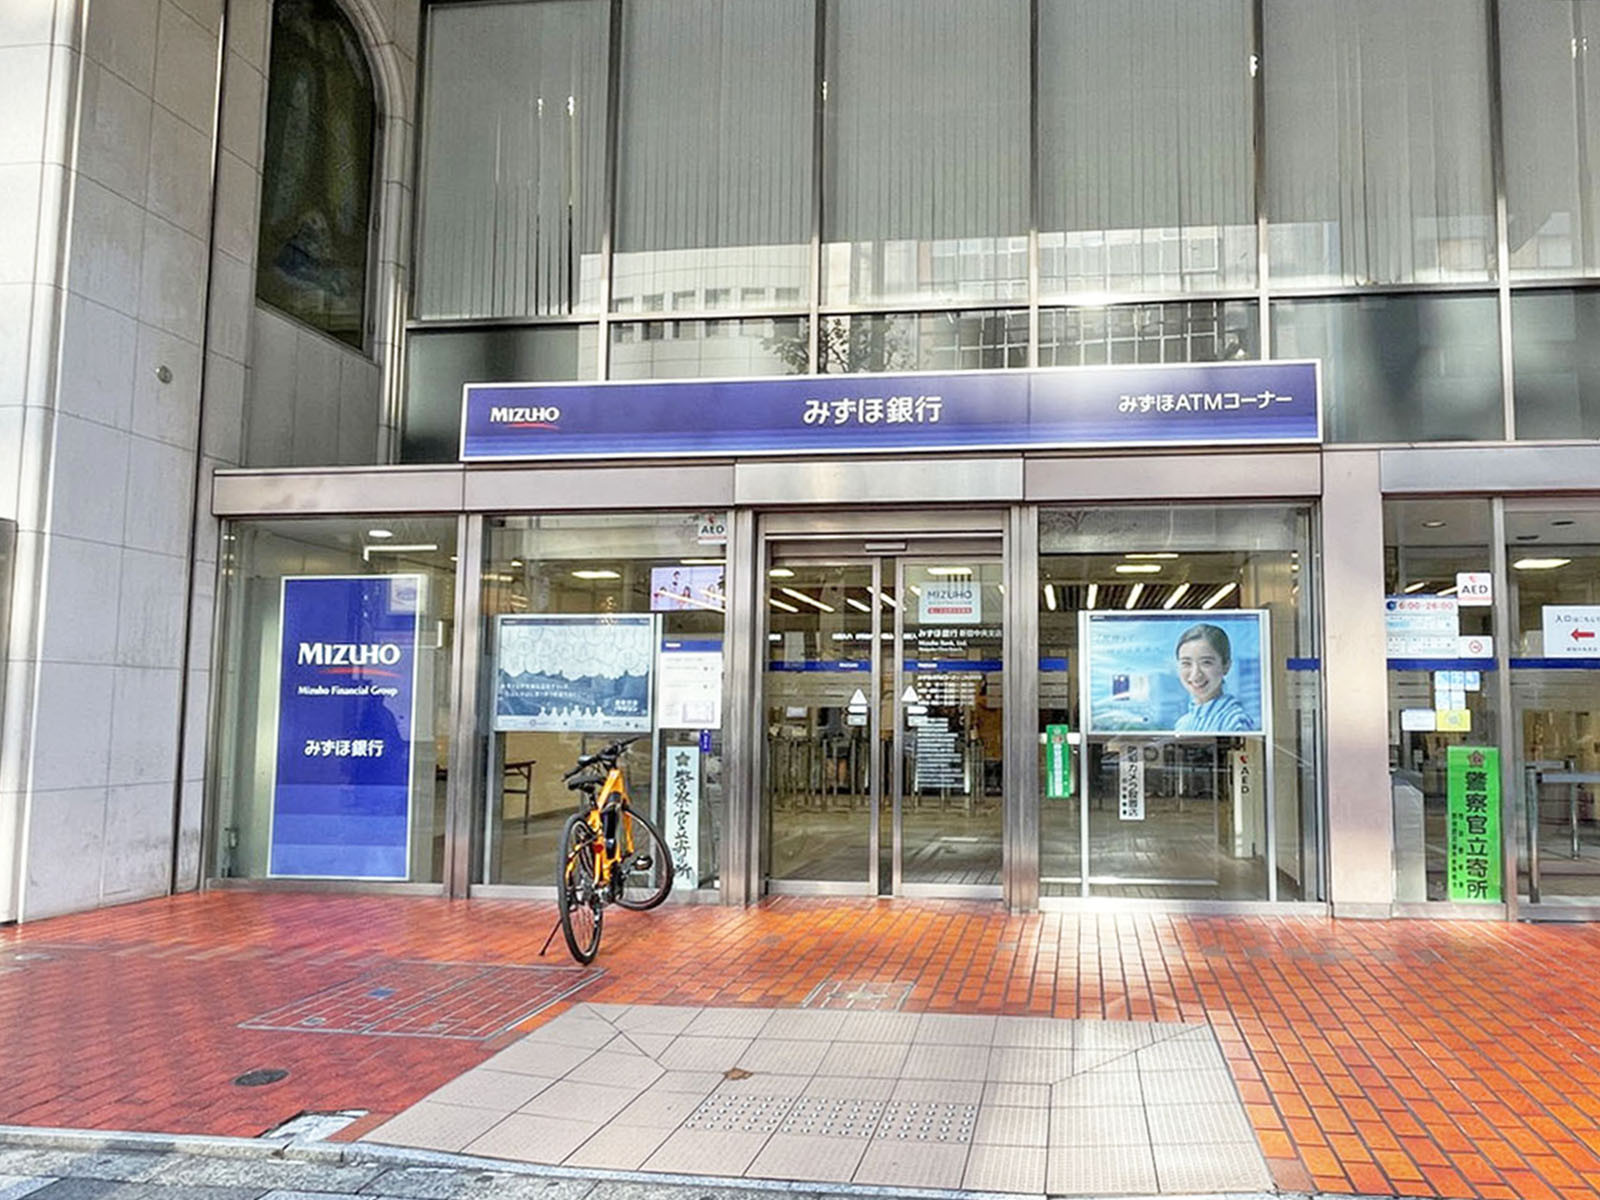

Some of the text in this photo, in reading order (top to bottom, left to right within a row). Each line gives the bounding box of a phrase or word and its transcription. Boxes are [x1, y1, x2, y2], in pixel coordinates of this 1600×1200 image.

[803, 396, 943, 425] みずほ銀行
[1118, 390, 1293, 413] みずほATMコーナー
[490, 407, 560, 422] MIZUHO
[1461, 584, 1489, 595] AED
[298, 642, 402, 666] MIZUHO
[298, 684, 399, 697] Mizuho Financial Group
[304, 739, 384, 758] みずほ銀行
[673, 769, 695, 880] 警察官立寄所
[1465, 771, 1488, 899] 警察官立寄所
